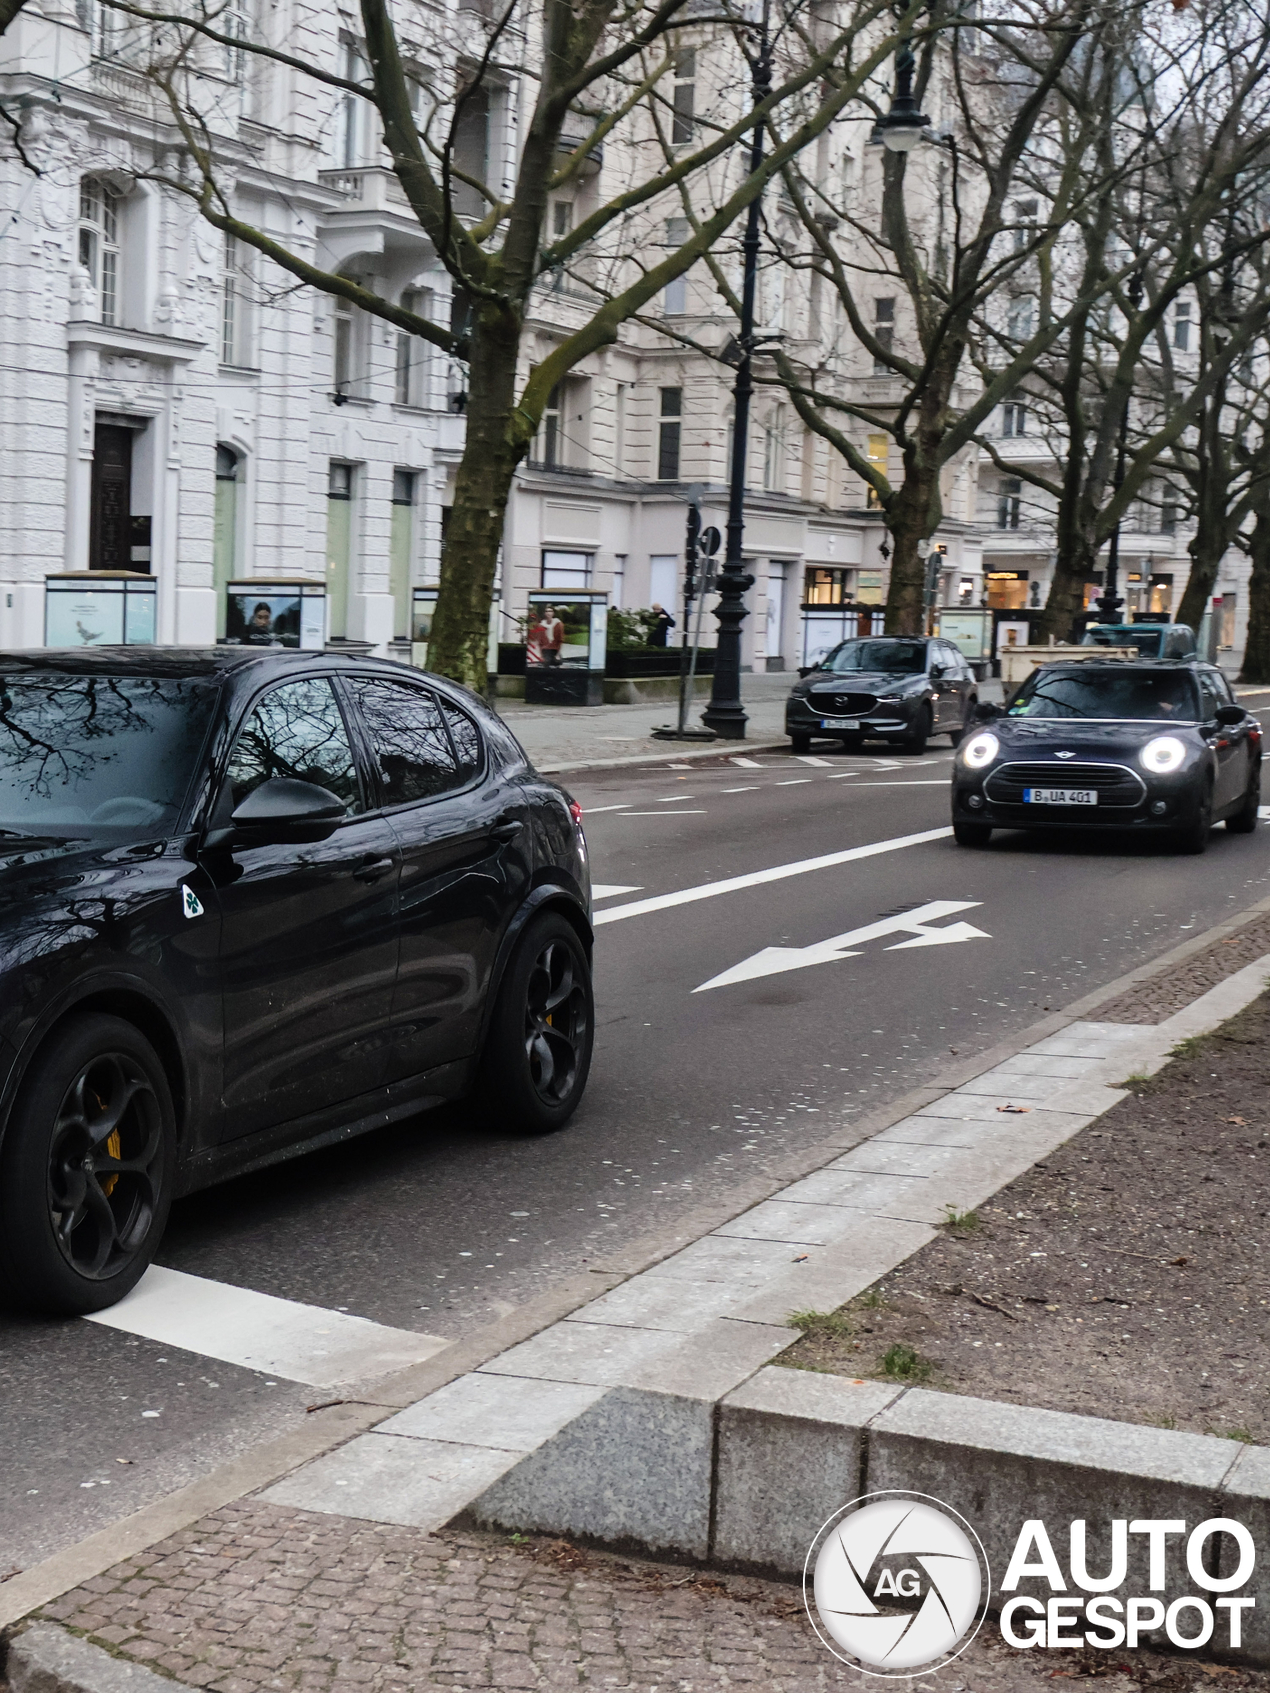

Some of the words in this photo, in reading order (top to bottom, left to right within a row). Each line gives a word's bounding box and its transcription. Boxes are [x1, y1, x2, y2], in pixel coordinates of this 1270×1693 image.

[1034, 790, 1043, 802] B
[1050, 791, 1066, 802] UA
[1069, 792, 1092, 803] 401
